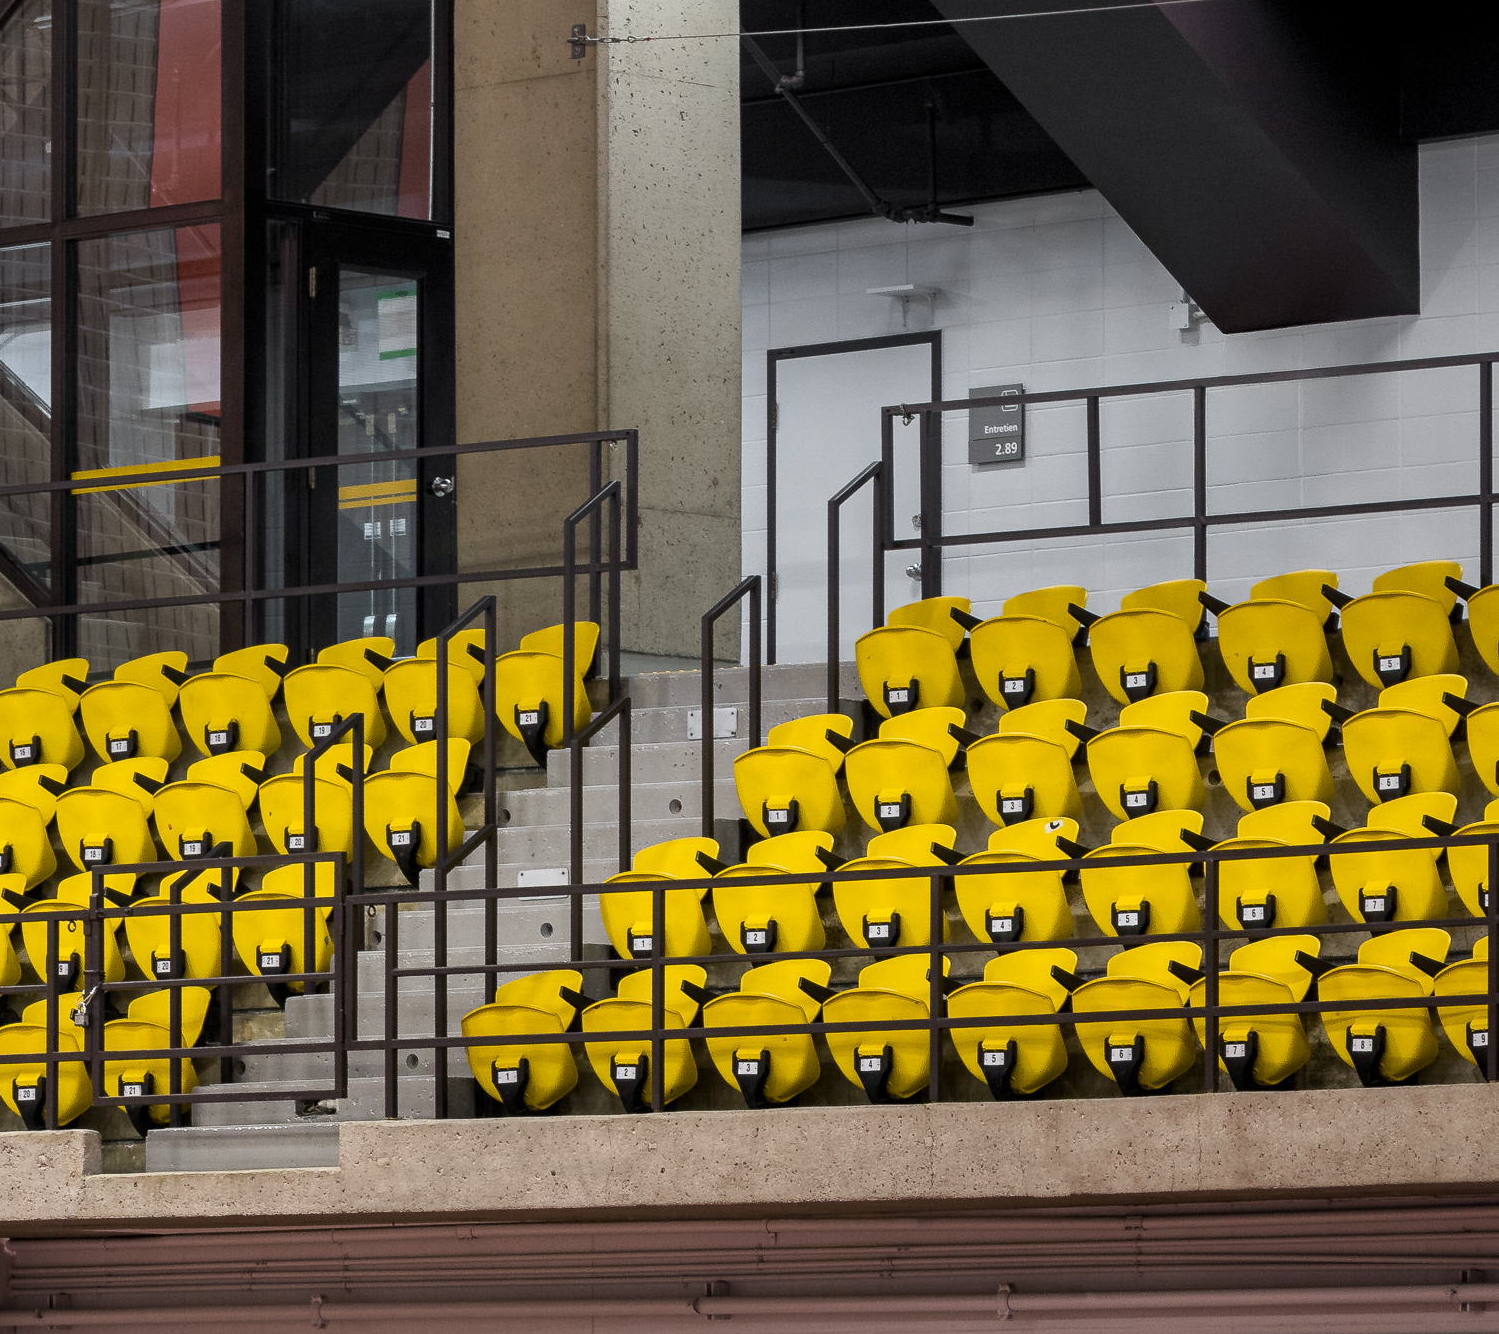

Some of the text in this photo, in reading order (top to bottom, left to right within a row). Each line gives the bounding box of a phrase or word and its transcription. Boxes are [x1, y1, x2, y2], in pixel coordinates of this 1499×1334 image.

[984, 423, 1018, 434] Entretien
[995, 441, 1018, 456] 2.89
[1387, 659, 1393, 669] 5
[1261, 667, 1267, 676] 4
[1133, 676, 1139, 685] 3
[1011, 681, 1017, 691] 2
[525, 714, 532, 723] 21
[419, 720, 427, 729] 20
[318, 726, 326, 735] 19
[214, 734, 221, 743] 18
[115, 742, 123, 751] 17
[19, 748, 26, 756] 16
[1386, 777, 1391, 787] 6
[1261, 787, 1266, 797] 5
[1134, 795, 1139, 804] 4
[887, 806, 892, 815] 2
[1010, 801, 1015, 811] 3
[294, 837, 302, 847] 20
[397, 834, 405, 843] 21
[189, 844, 196, 853] 19
[89, 849, 97, 859] 18
[1372, 900, 1377, 910] 7
[1251, 908, 1257, 918] 6
[1125, 914, 1130, 924] 5
[1000, 921, 1005, 930] 4
[876, 926, 881, 936] 3
[753, 932, 758, 942] 2
[266, 956, 274, 965] 21
[161, 961, 169, 971] 20
[1480, 1033, 1486, 1044] 9
[1360, 1039, 1366, 1050] 8
[1119, 1049, 1124, 1059] 6
[1232, 1045, 1238, 1055] 7
[991, 1053, 997, 1064] 5
[745, 1063, 751, 1073] 3
[868, 1059, 873, 1069] 4
[623, 1067, 629, 1077] 2
[22, 1089, 31, 1099] 20
[128, 1086, 137, 1095] 21
